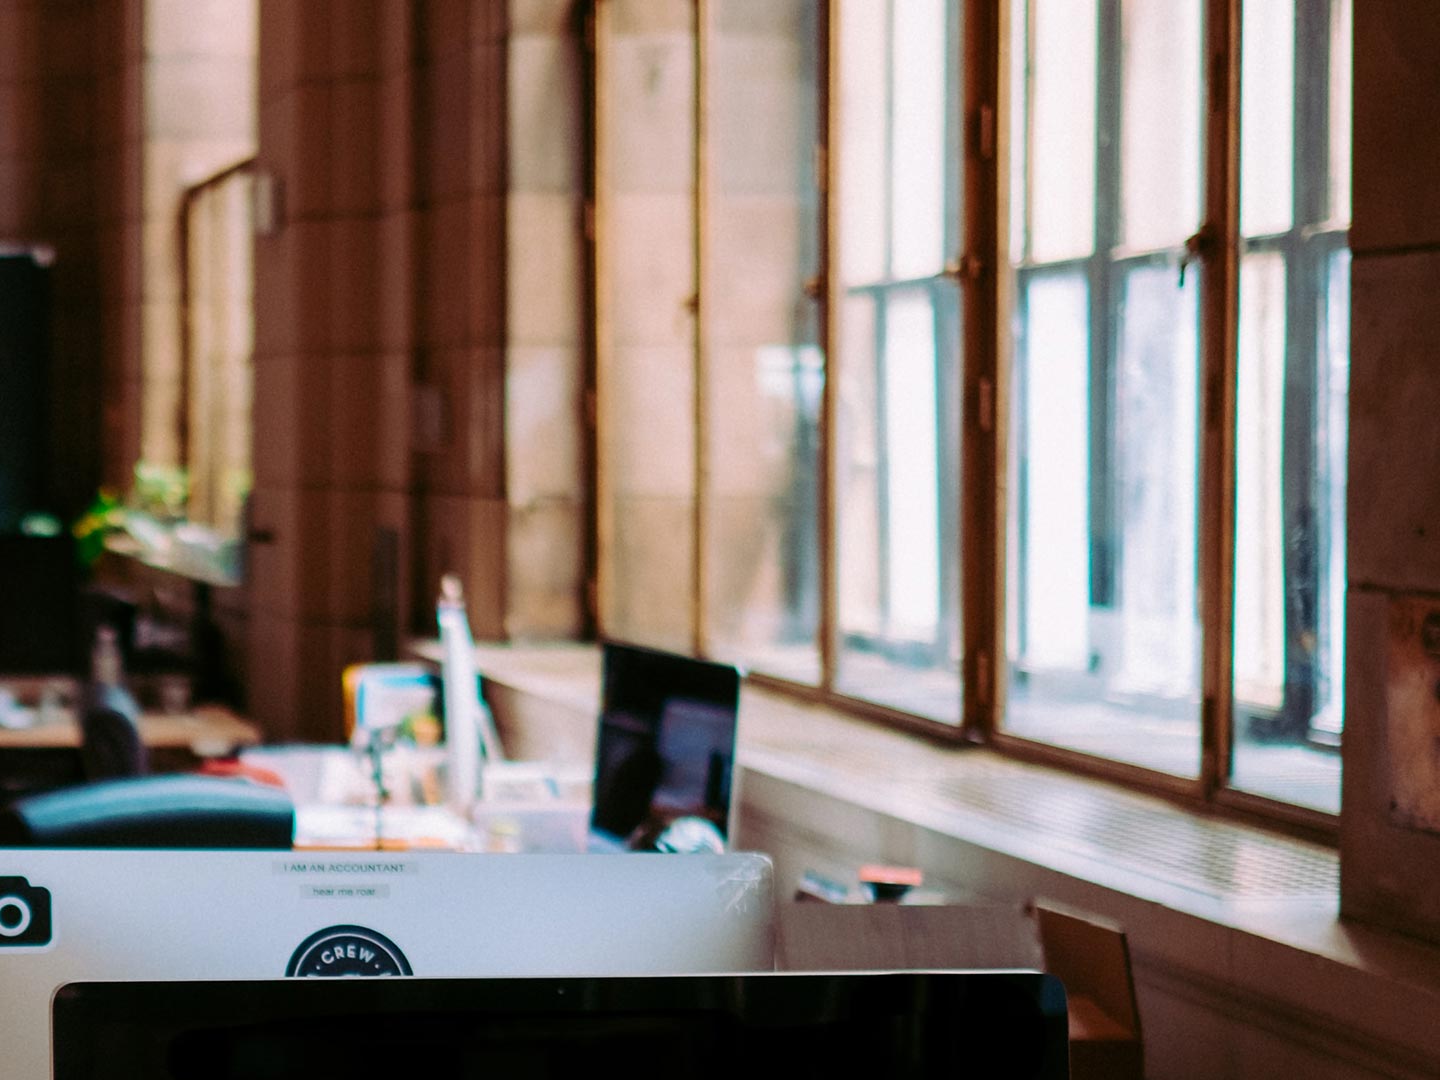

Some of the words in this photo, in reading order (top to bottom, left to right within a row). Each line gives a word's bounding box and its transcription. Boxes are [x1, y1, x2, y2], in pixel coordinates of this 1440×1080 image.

[290, 864, 307, 873] AM
[309, 864, 325, 873] AN
[328, 864, 405, 873] ACCOUNTANT
[321, 945, 375, 964] CREW
